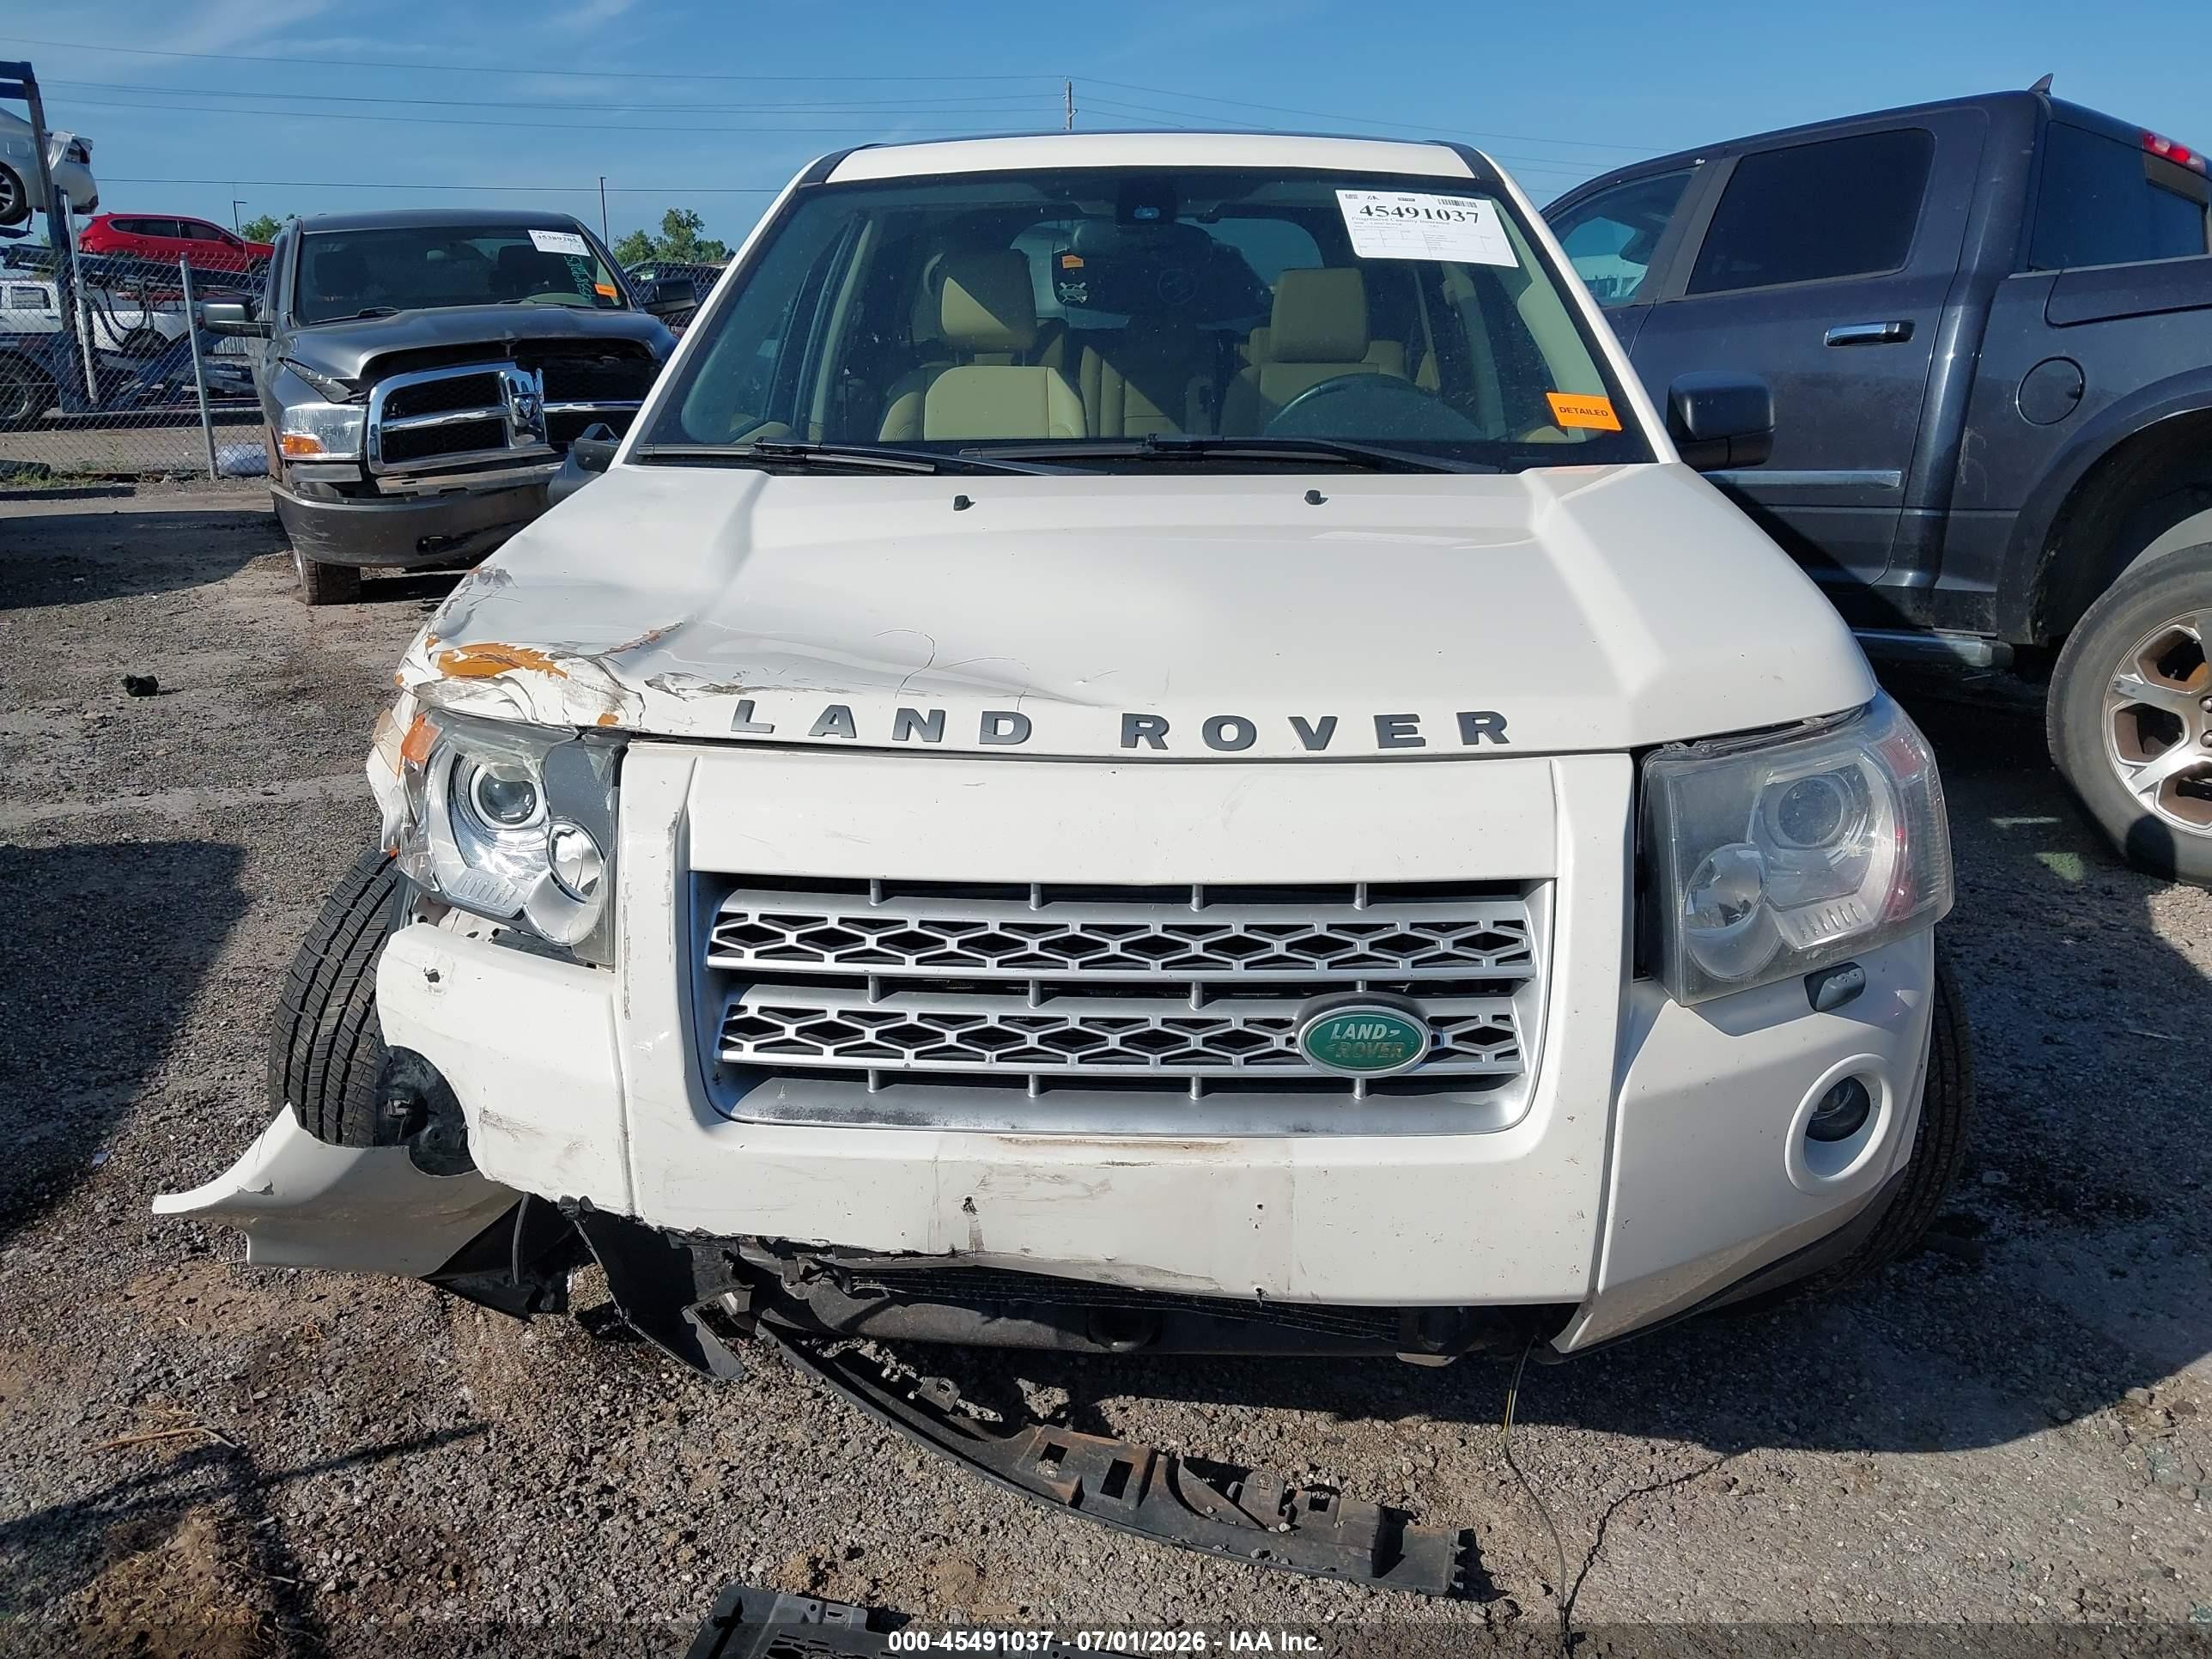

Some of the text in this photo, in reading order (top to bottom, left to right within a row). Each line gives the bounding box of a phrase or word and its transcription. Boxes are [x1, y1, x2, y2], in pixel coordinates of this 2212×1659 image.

[1359, 204, 1480, 224] 45491037
[1559, 406, 1608, 416] DETAILED
[730, 699, 1511, 752] LAND ROVER
